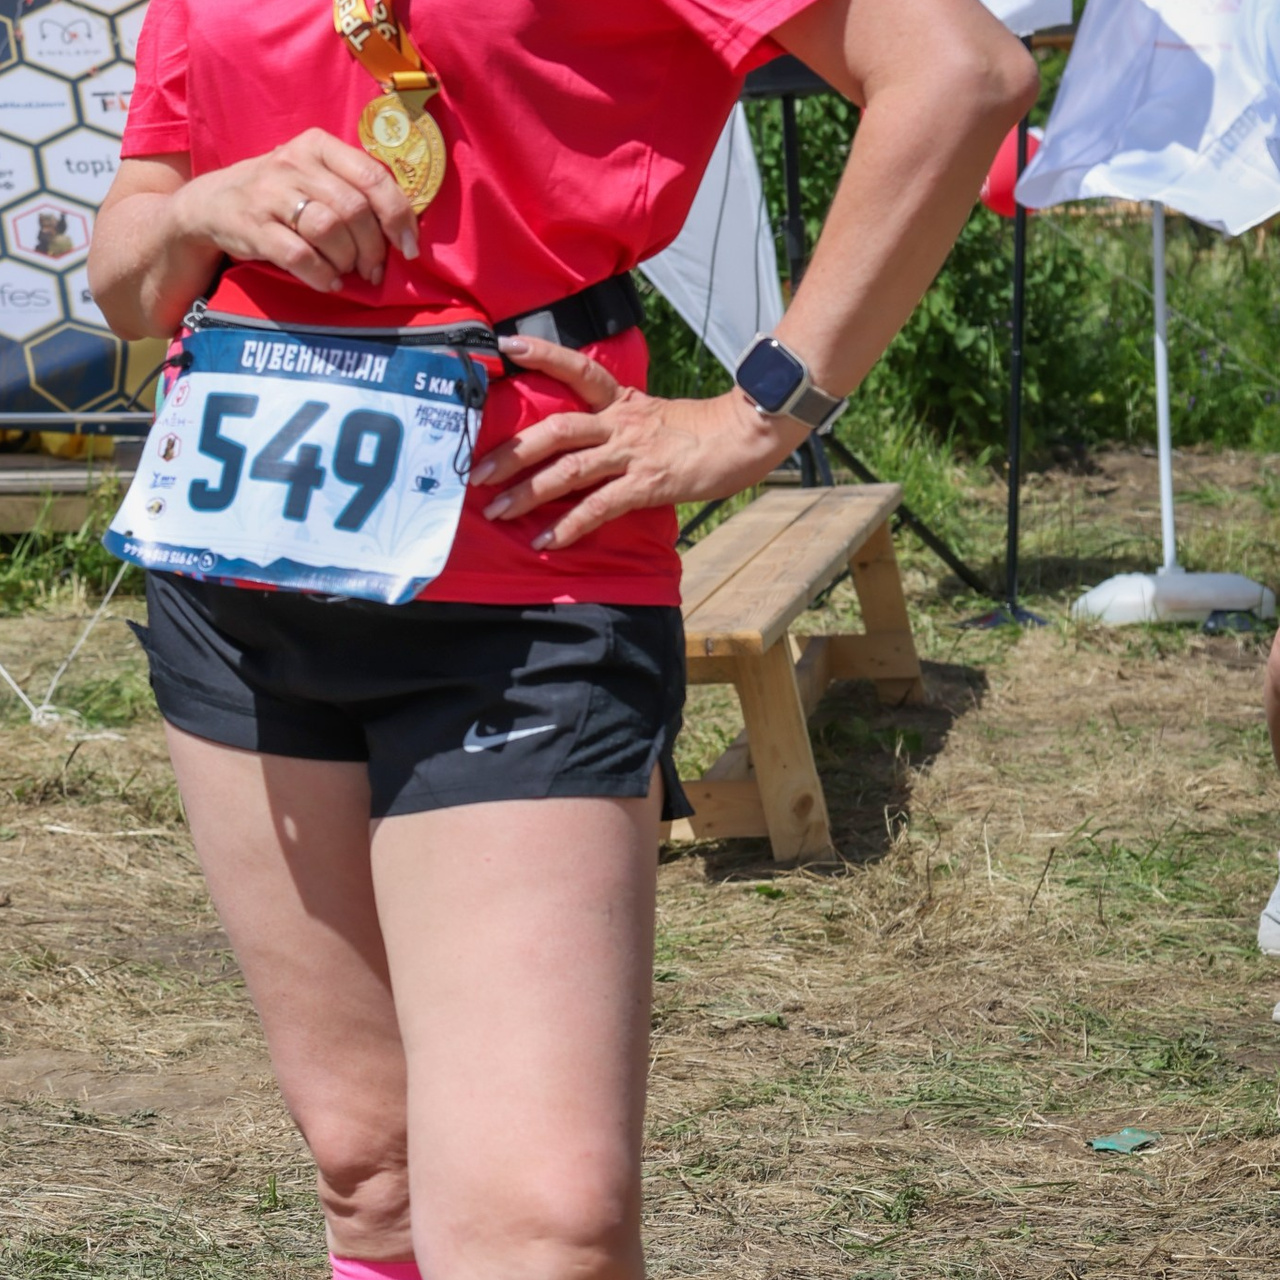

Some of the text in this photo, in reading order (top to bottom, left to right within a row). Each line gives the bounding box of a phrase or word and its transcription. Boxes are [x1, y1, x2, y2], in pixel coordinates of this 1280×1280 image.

[240, 339, 389, 383] СУВЕНИРНАЯ
[414, 372, 427, 391] 5
[188, 392, 405, 533] 549
